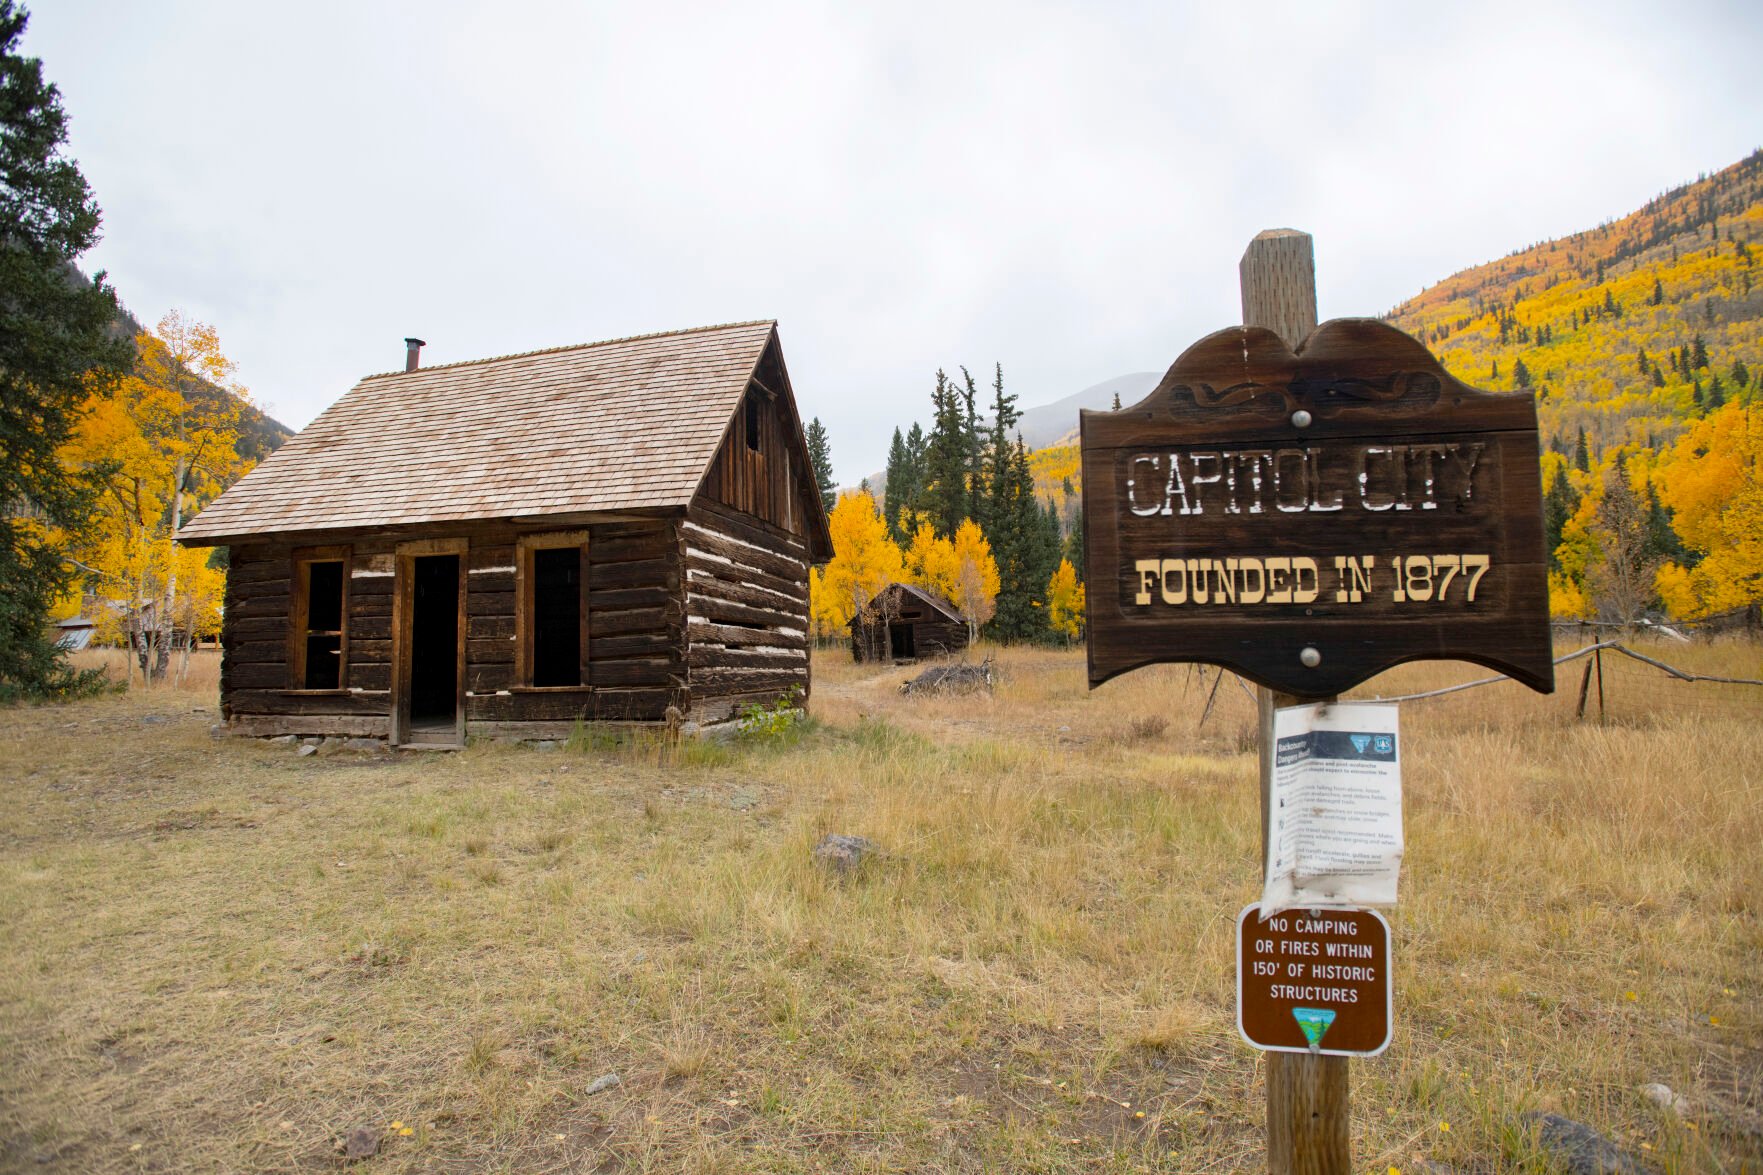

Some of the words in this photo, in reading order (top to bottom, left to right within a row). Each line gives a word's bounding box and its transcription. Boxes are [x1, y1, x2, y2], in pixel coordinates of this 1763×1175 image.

[1127, 448, 1343, 516] CAPITOL
[1358, 442, 1486, 511] CITY
[1135, 556, 1319, 605] FOUNDED
[1335, 555, 1375, 603] IN
[1392, 554, 1490, 603] 1877
[1269, 918, 1288, 932] NO
[1295, 919, 1357, 936] CAMPING
[1255, 939, 1274, 953] OR
[1281, 940, 1319, 956] FIRES
[1326, 943, 1373, 959] WITHIN
[1253, 961, 1280, 976] 150'
[1288, 963, 1305, 977] OF
[1312, 964, 1375, 982] HISTORIC
[1270, 985, 1358, 1003] STRUCTURES
